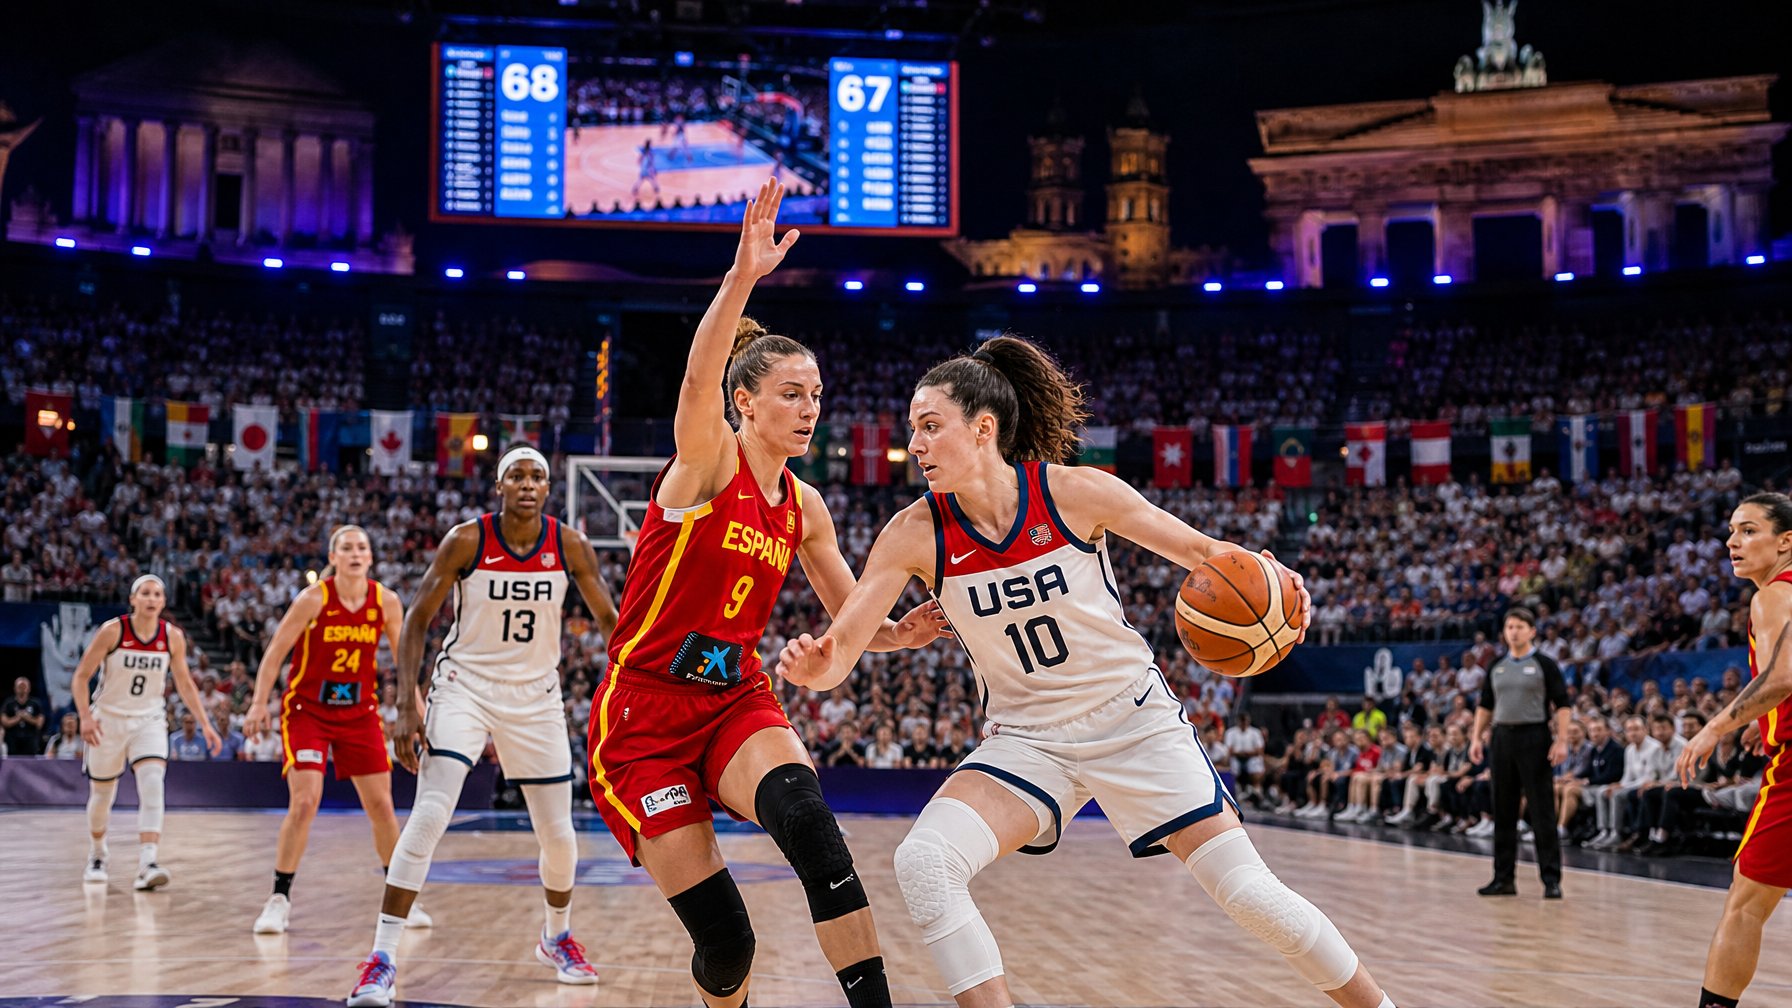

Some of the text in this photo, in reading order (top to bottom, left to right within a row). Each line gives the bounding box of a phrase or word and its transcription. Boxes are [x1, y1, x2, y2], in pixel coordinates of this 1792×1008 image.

[501, 62, 559, 102] 68
[837, 74, 893, 113] 67
[721, 521, 791, 576] ESPAÑA
[488, 580, 552, 602] USA
[723, 575, 755, 619] 9
[967, 564, 1069, 617] USA
[323, 623, 377, 645] ESPAÑA
[502, 608, 536, 643] 13
[1004, 614, 1070, 674] 10
[124, 655, 162, 670] USA
[331, 648, 362, 674] 24
[130, 674, 146, 697] 8
